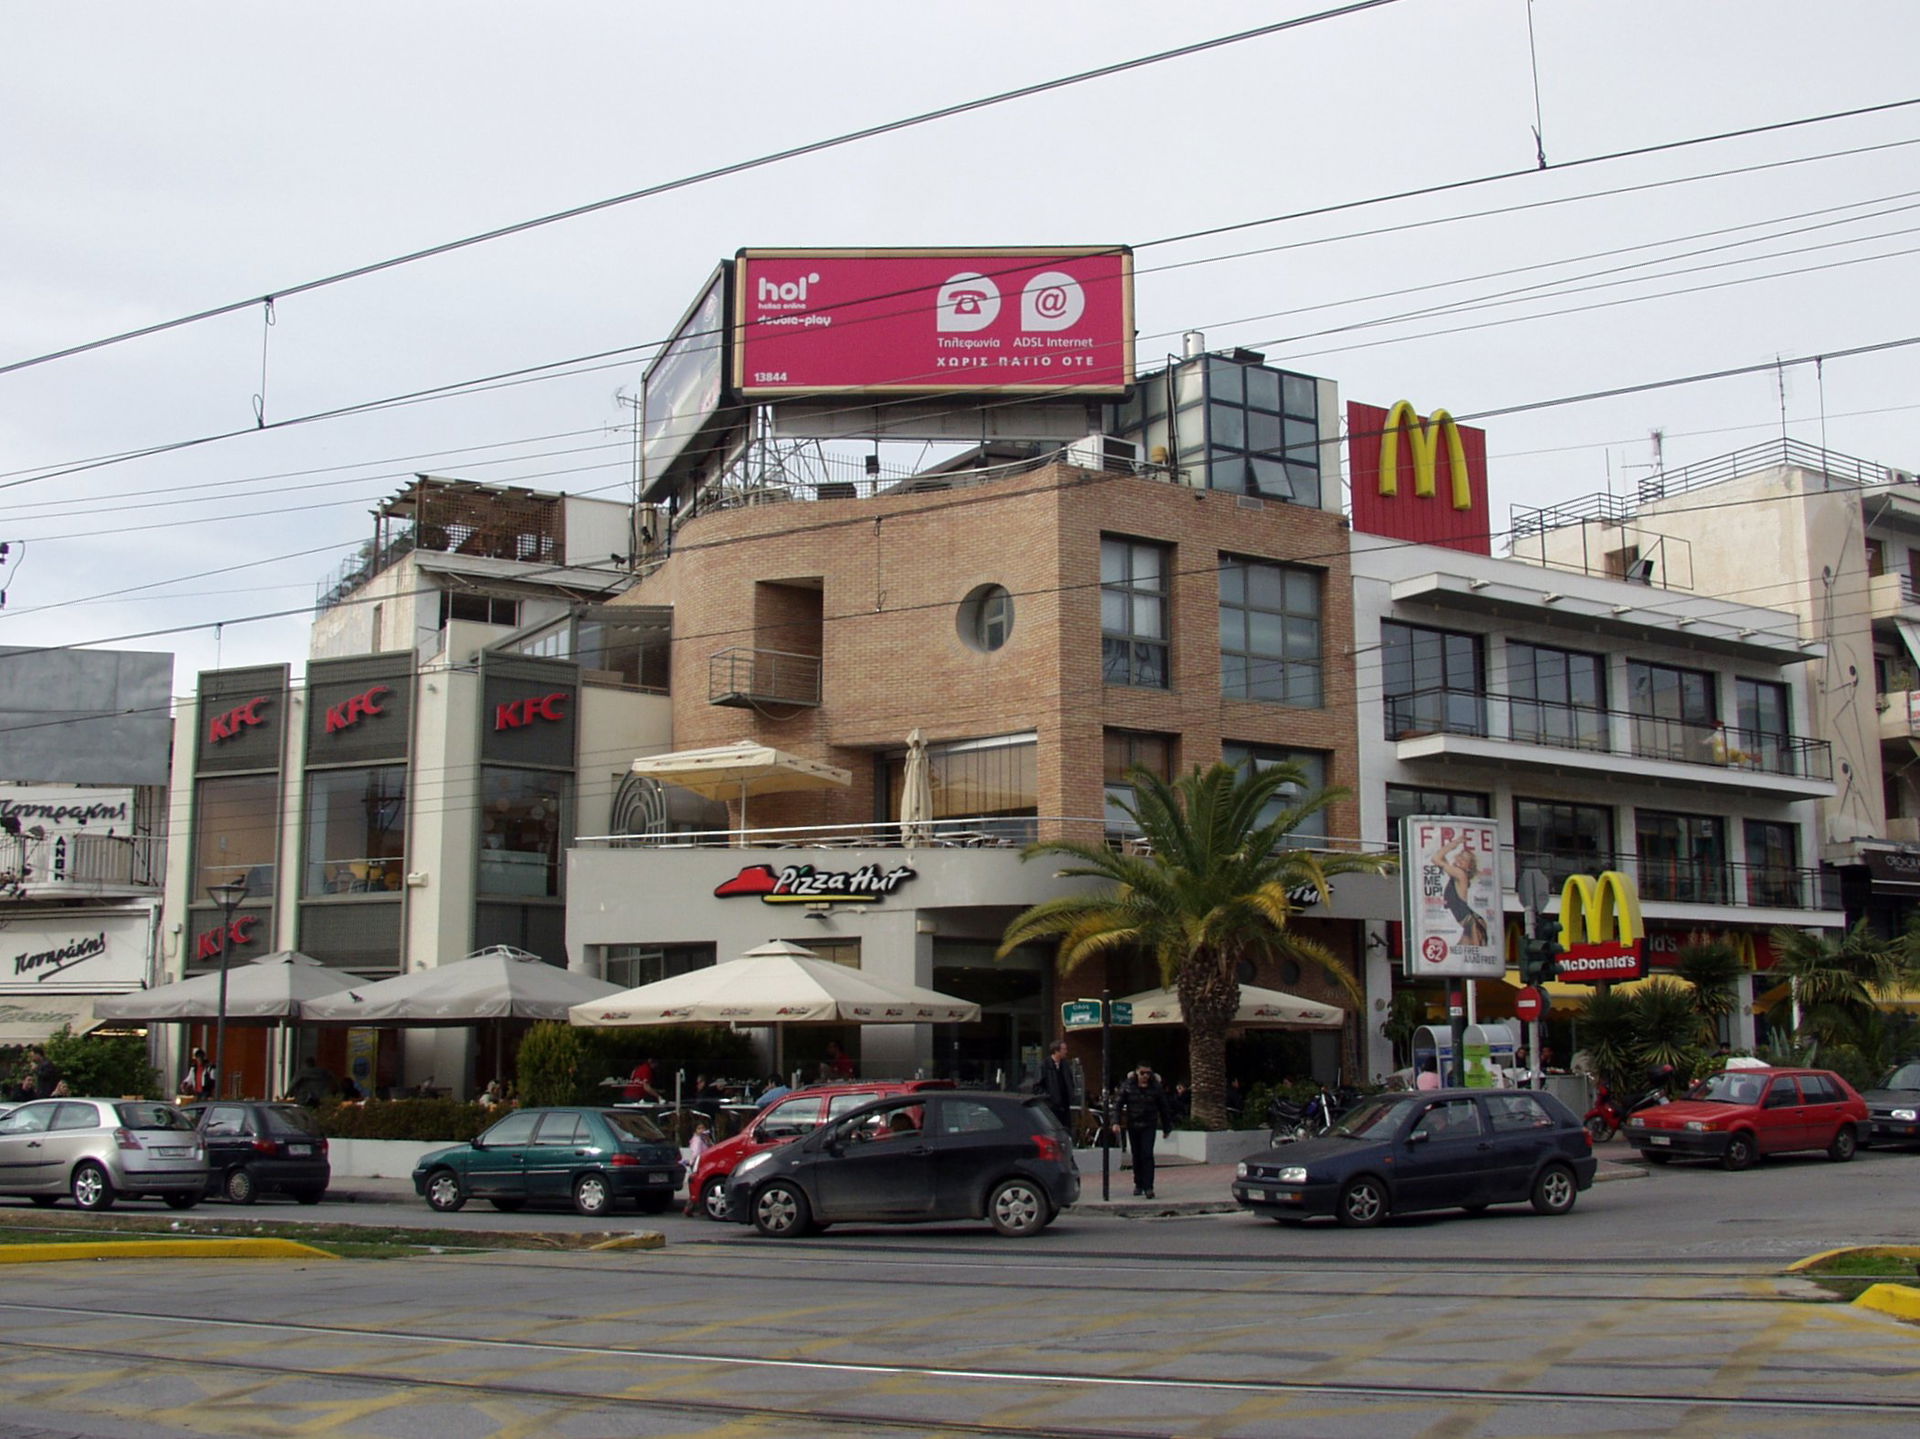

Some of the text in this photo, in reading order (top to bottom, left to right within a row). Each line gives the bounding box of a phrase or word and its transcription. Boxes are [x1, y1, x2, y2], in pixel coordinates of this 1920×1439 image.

[758, 276, 807, 301] hol
[937, 337, 1000, 349] Τηλεφωνία
[1013, 337, 1094, 348] ADSL Internet
[937, 356, 1094, 367] ΧΩΡΙΣ ΠΑΓΙΟ ΟΤΕ
[754, 371, 787, 382] 13844
[326, 685, 389, 733] KFC
[495, 692, 568, 731] KFC
[208, 696, 269, 743] KFC
[1420, 825, 1493, 852] FREE
[1423, 865, 1444, 876] SEX
[773, 865, 911, 894] Pizza Hut
[1424, 876, 1441, 886] ME
[1424, 886, 1443, 897] UP!
[1558, 955, 1636, 972] McDonald's
